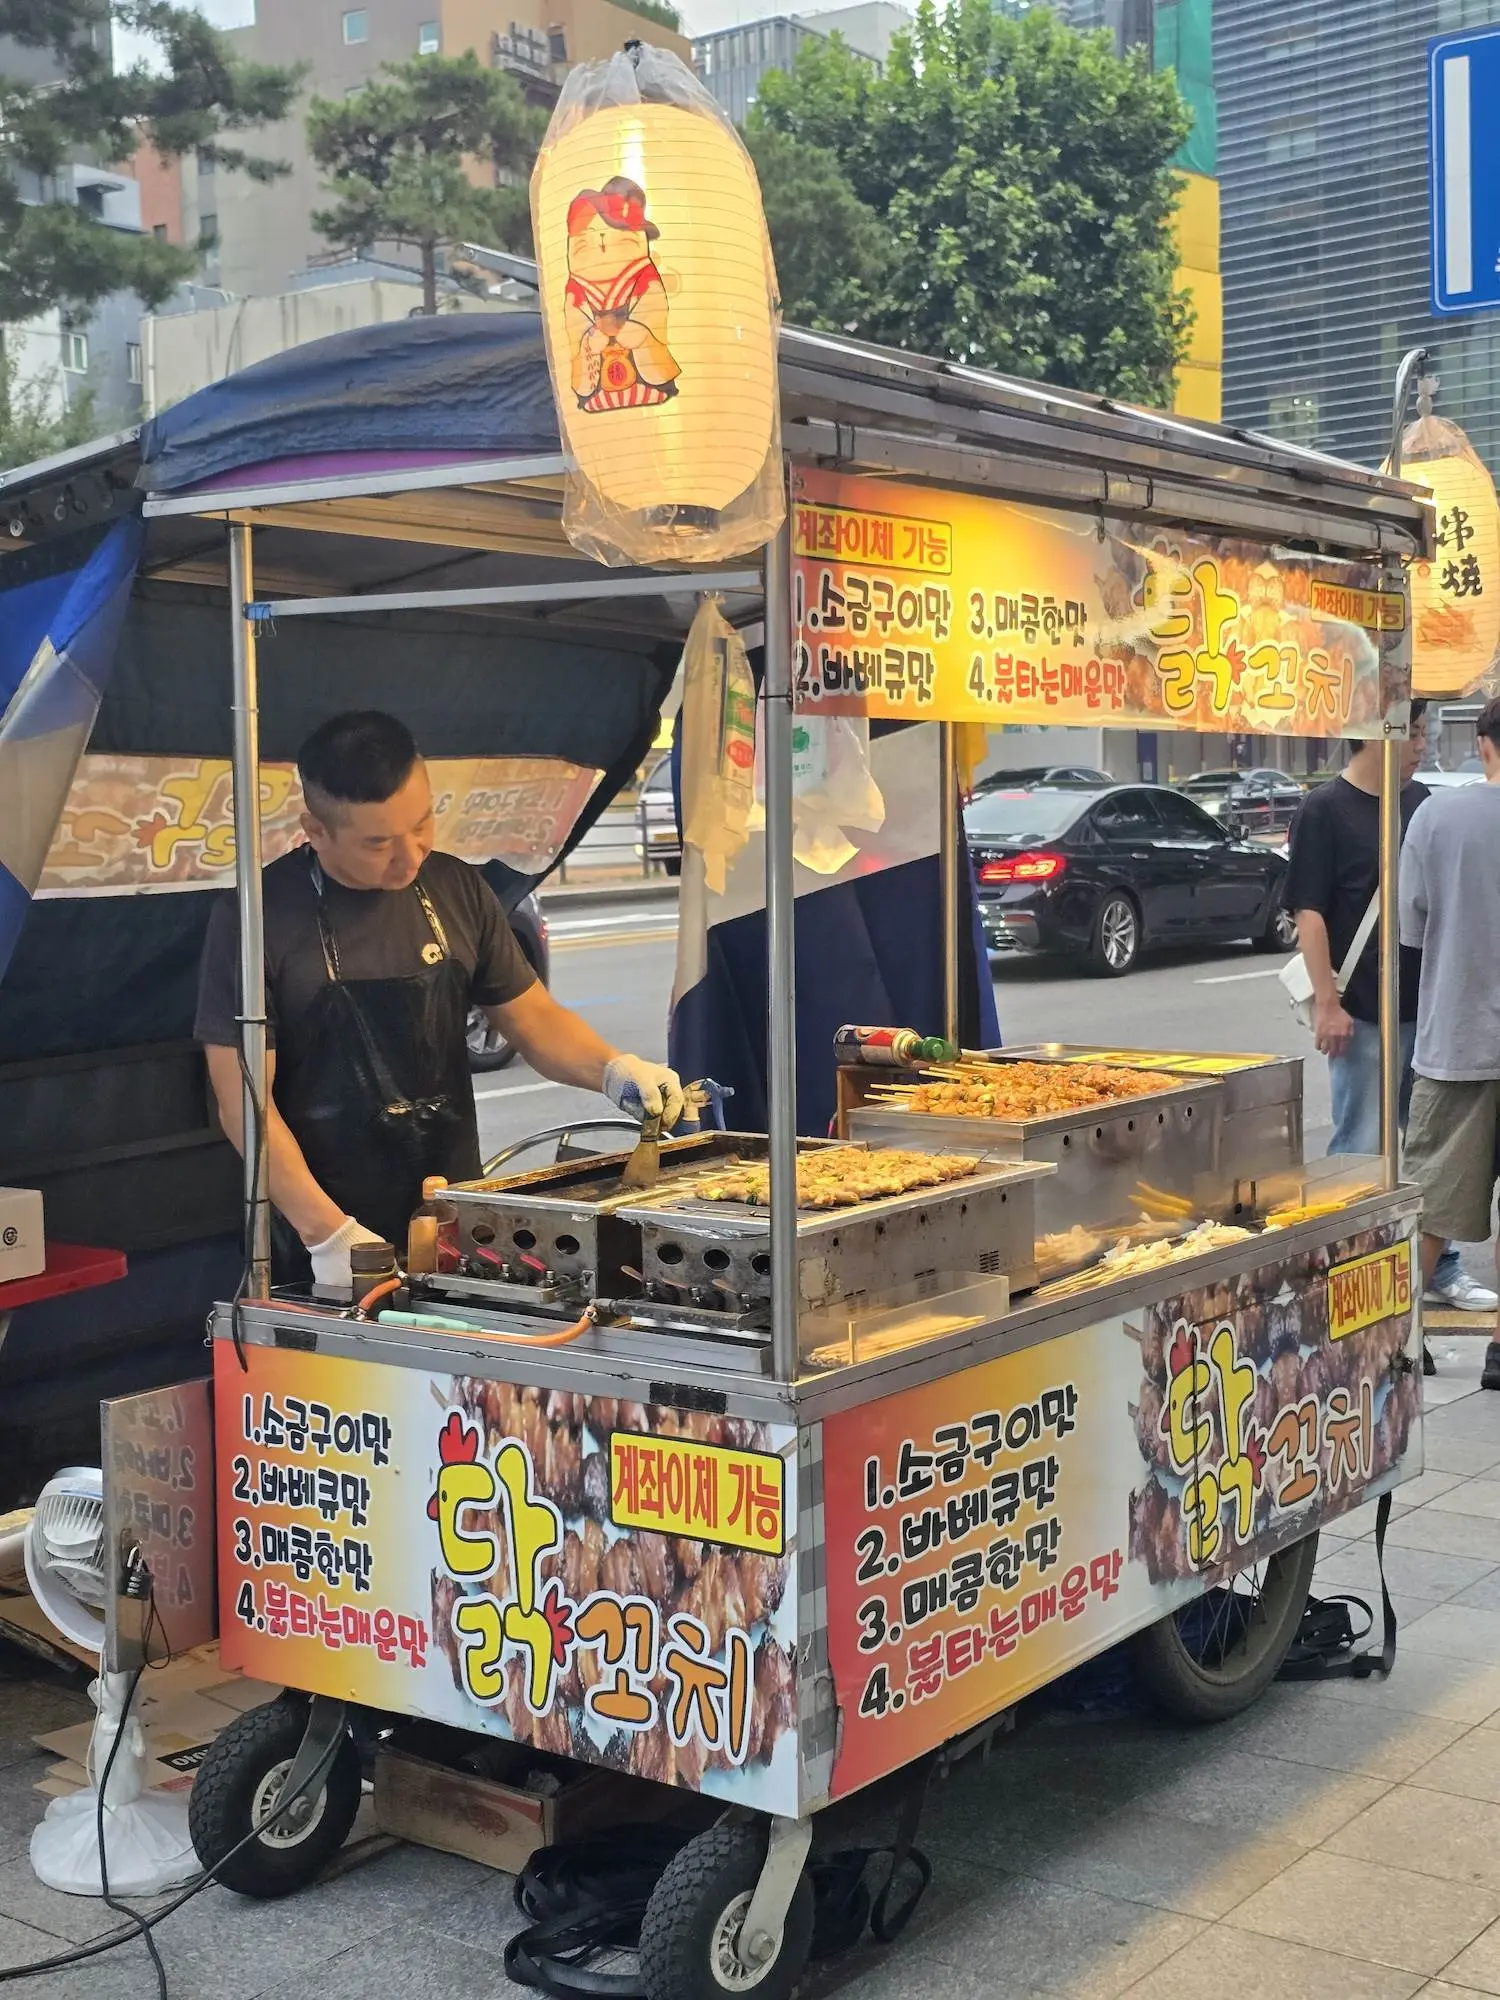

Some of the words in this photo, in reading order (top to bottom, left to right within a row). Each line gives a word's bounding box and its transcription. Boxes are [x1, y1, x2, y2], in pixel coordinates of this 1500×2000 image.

[797, 510, 894, 561] 계좌이체
[902, 526, 949, 567] 가능
[796, 573, 951, 638] 1.소금구이맛
[970, 591, 1088, 648] 3.매콤한맛
[1143, 558, 1354, 718] 닭꼬치
[1313, 586, 1364, 622] 계좌이체
[795, 643, 934, 703] 2.바베큐맛
[968, 652, 1126, 710] 4.불타는매운맛
[1329, 1261, 1383, 1328] 계좌이체
[244, 1395, 392, 1466] 1.소금구이맛
[866, 1384, 1079, 1508] 1.소금구이맛
[1169, 1328, 1373, 1563] 닭꼬치
[233, 1457, 371, 1527] 2.바베큐맛
[613, 1443, 719, 1529] 계좌이체
[727, 1464, 781, 1541] 가능
[856, 1456, 1060, 1582] 2.바베큐맛
[234, 1520, 373, 1592] 3.매콤한맛
[858, 1518, 1062, 1651] 3.매콤한맛
[237, 1582, 429, 1668] 4.불타는매운맛
[438, 1443, 750, 1758] 닭꼬치
[859, 1548, 1124, 1717] 4.불타는매운맛
